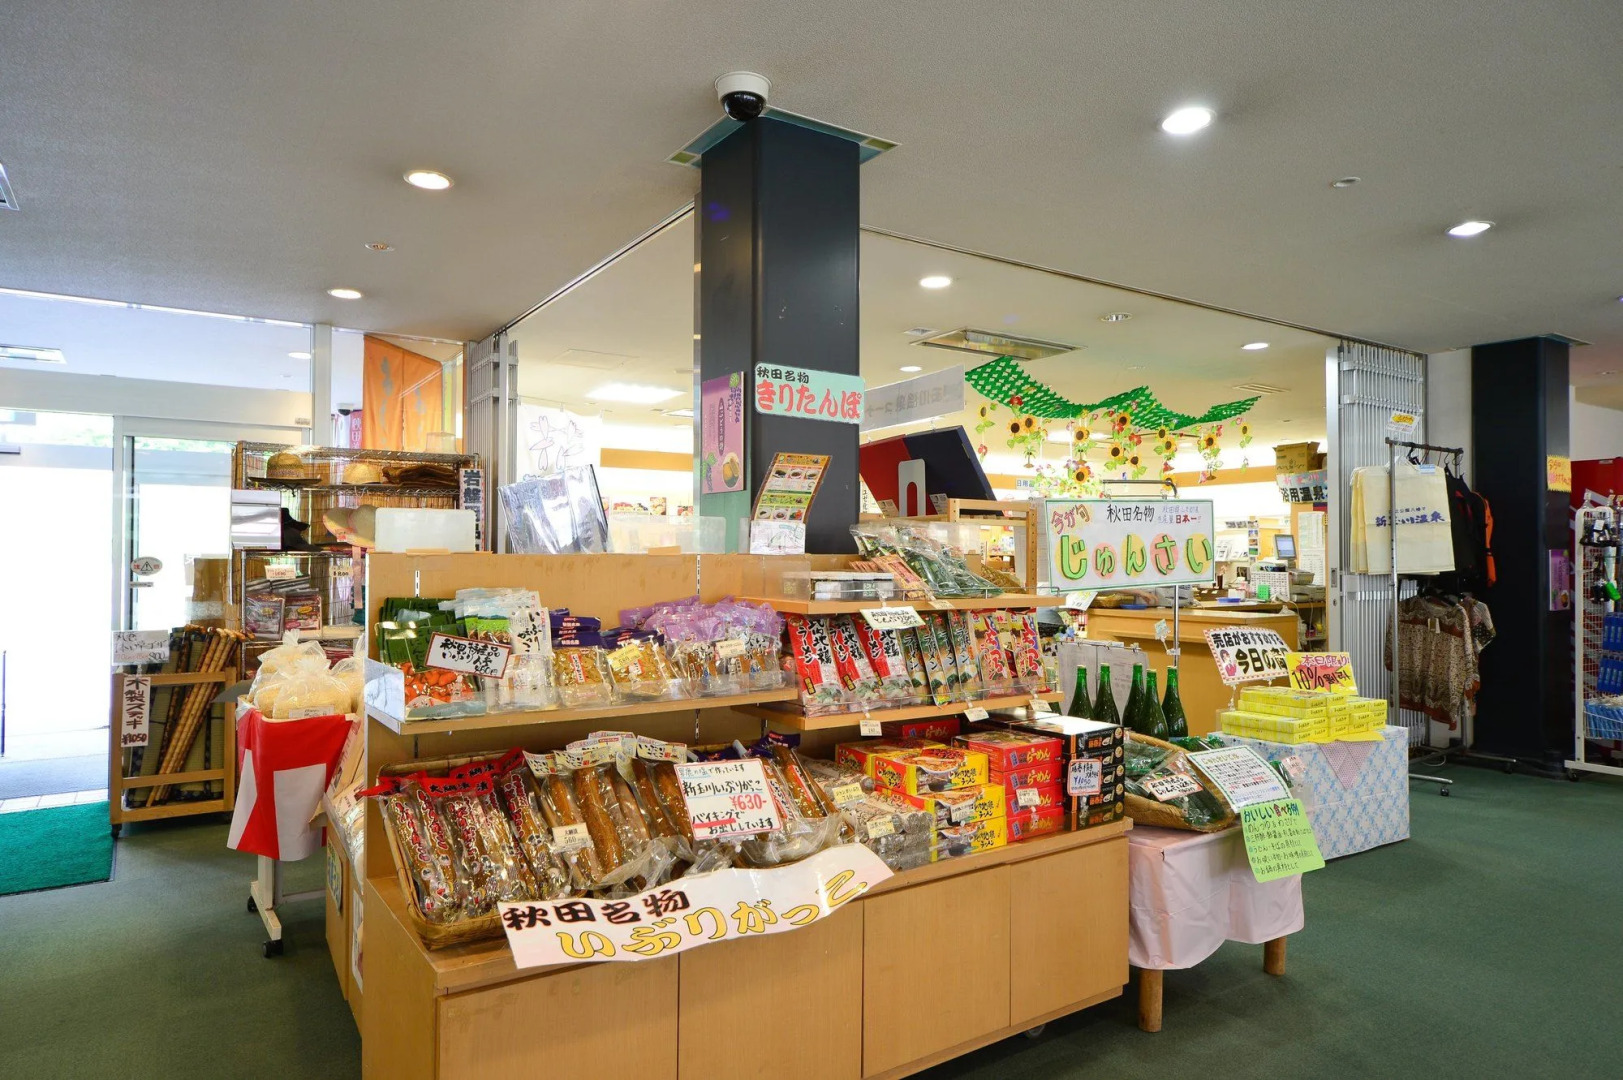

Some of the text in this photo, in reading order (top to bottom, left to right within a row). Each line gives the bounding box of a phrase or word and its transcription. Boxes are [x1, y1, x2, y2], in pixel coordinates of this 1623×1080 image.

[757, 365, 809, 385] 秋田名物
[757, 379, 863, 419] きりたんぽ
[1280, 485, 1327, 502] 浴用温泉
[1051, 503, 1091, 534] 今が旬
[1106, 504, 1155, 523] 秋田名物
[1060, 533, 1213, 581] じゅんさい
[440, 638, 500, 657] 秋田特産品
[797, 626, 814, 664] ラーメン
[829, 627, 849, 663] ラーメン
[880, 629, 900, 658] 地鶏
[1211, 632, 1285, 649] 売店がおすすめする
[1027, 747, 1050, 764] らーめん
[1028, 769, 1051, 786] らーめん
[682, 780, 763, 797] 新玉川いぶりがっこ
[692, 809, 745, 825] バイキングで
[708, 818, 773, 835] お出ししています
[503, 889, 690, 931] 秋田名物
[555, 868, 868, 960] いぶりがっこ
